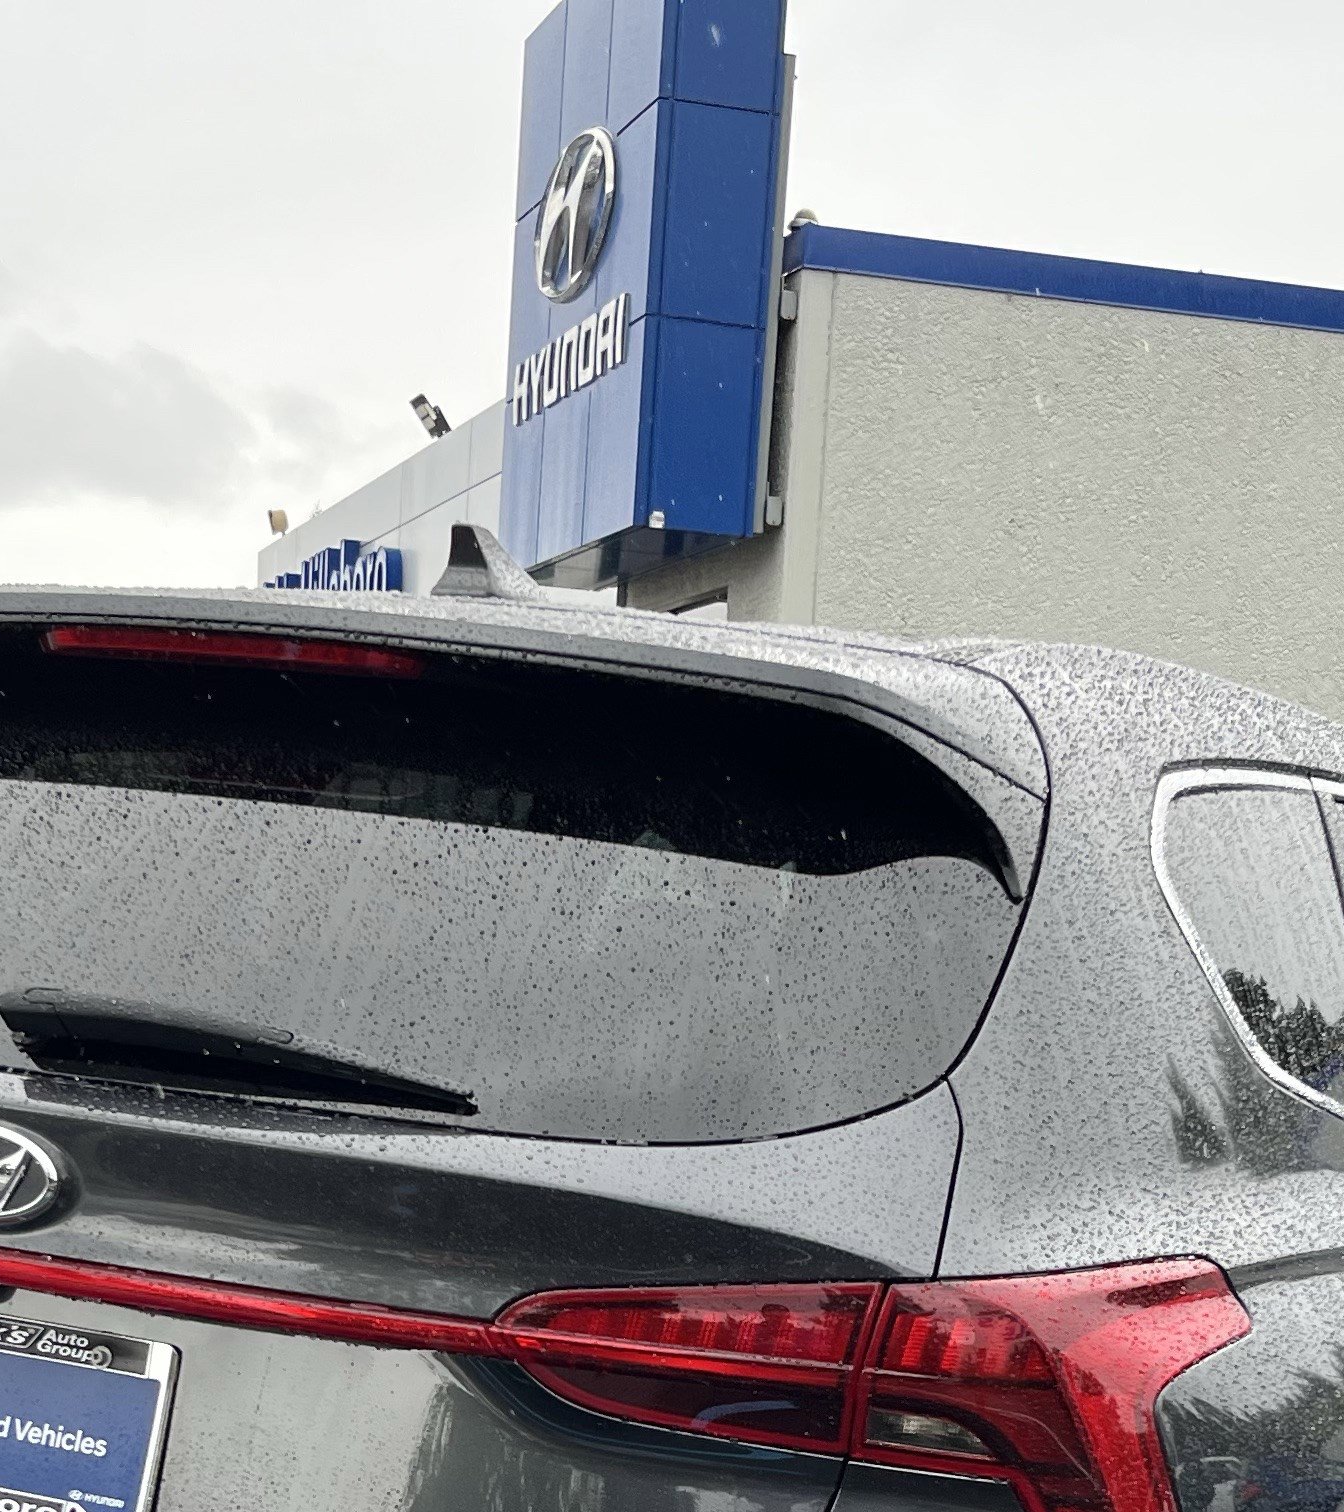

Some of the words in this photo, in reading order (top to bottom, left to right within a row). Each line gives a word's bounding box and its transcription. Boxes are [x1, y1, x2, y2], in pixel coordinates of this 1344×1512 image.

[512, 292, 631, 427] HYUNDAI
[36, 1339, 98, 1363] Group
[41, 1328, 89, 1348] Auto
[14, 1418, 108, 1457] Vehicles
